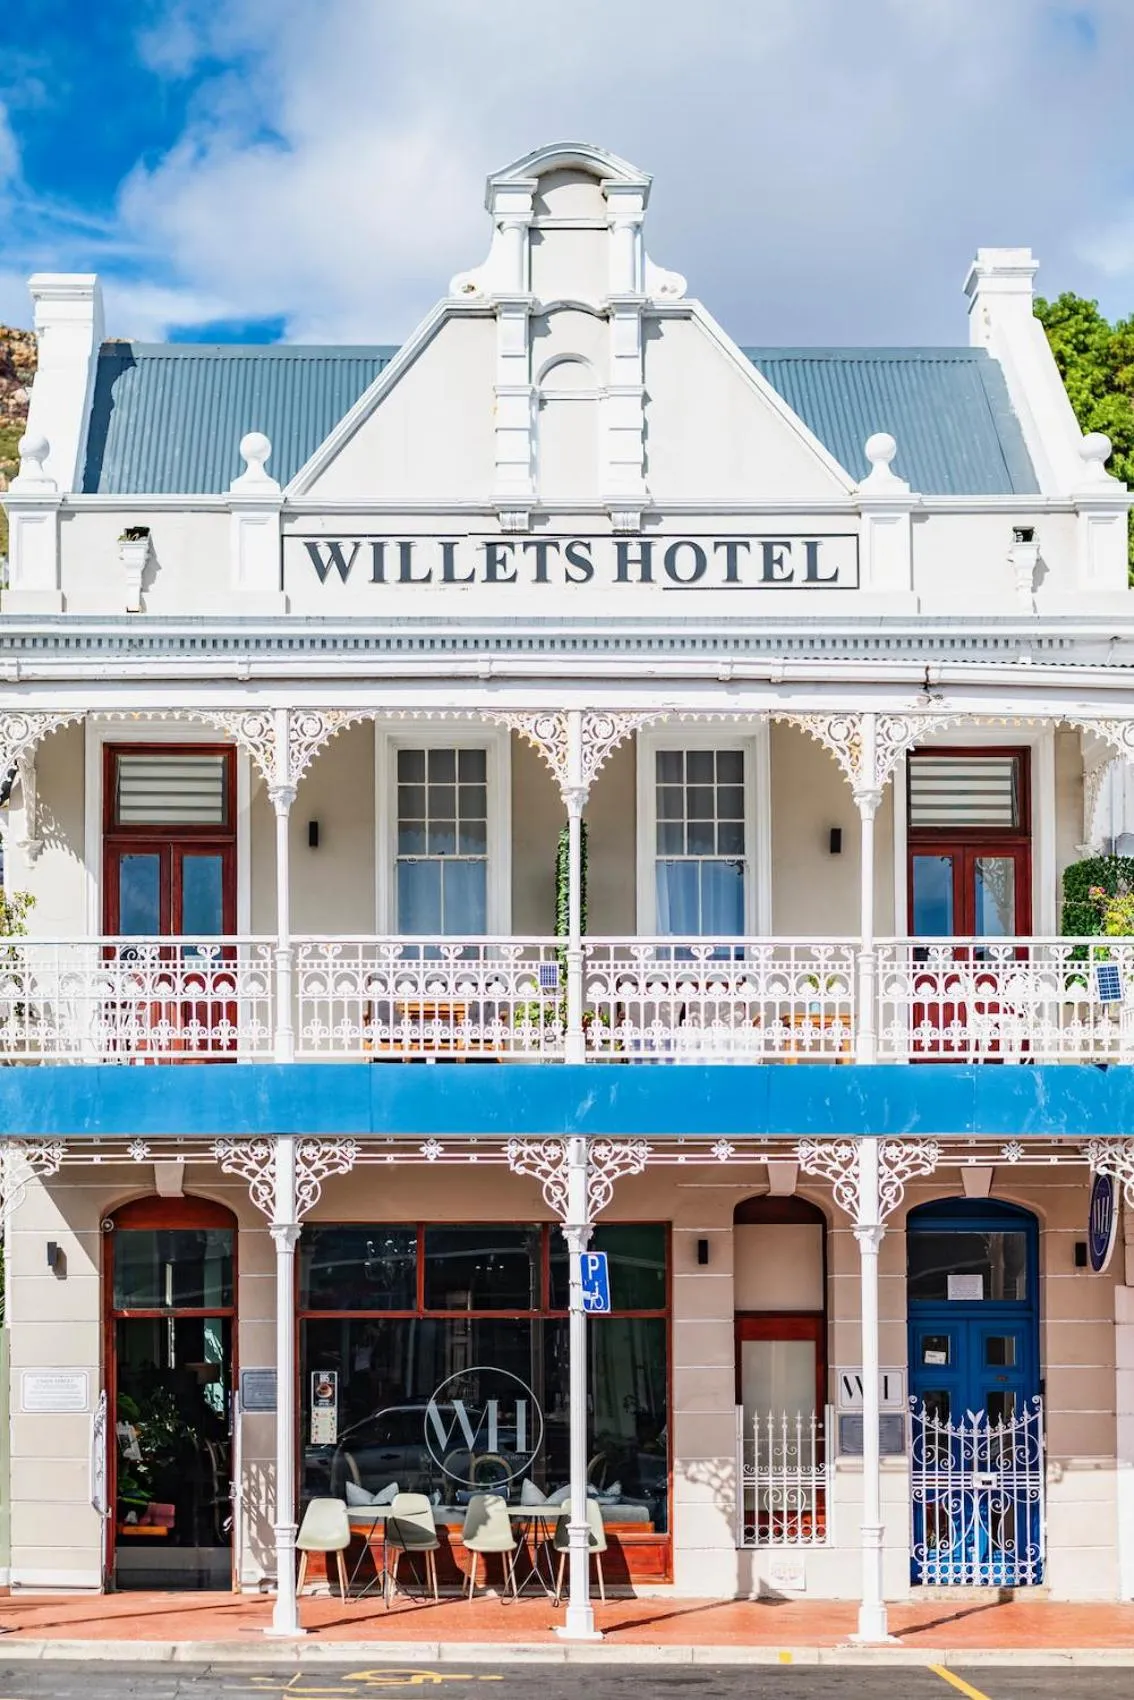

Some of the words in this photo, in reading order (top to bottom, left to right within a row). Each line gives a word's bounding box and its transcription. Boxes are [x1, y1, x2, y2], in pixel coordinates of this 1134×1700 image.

[303, 540, 594, 585] WILLETS
[612, 540, 839, 584] HOTEL
[587, 1255, 600, 1280] P
[425, 1399, 536, 1453] WH
